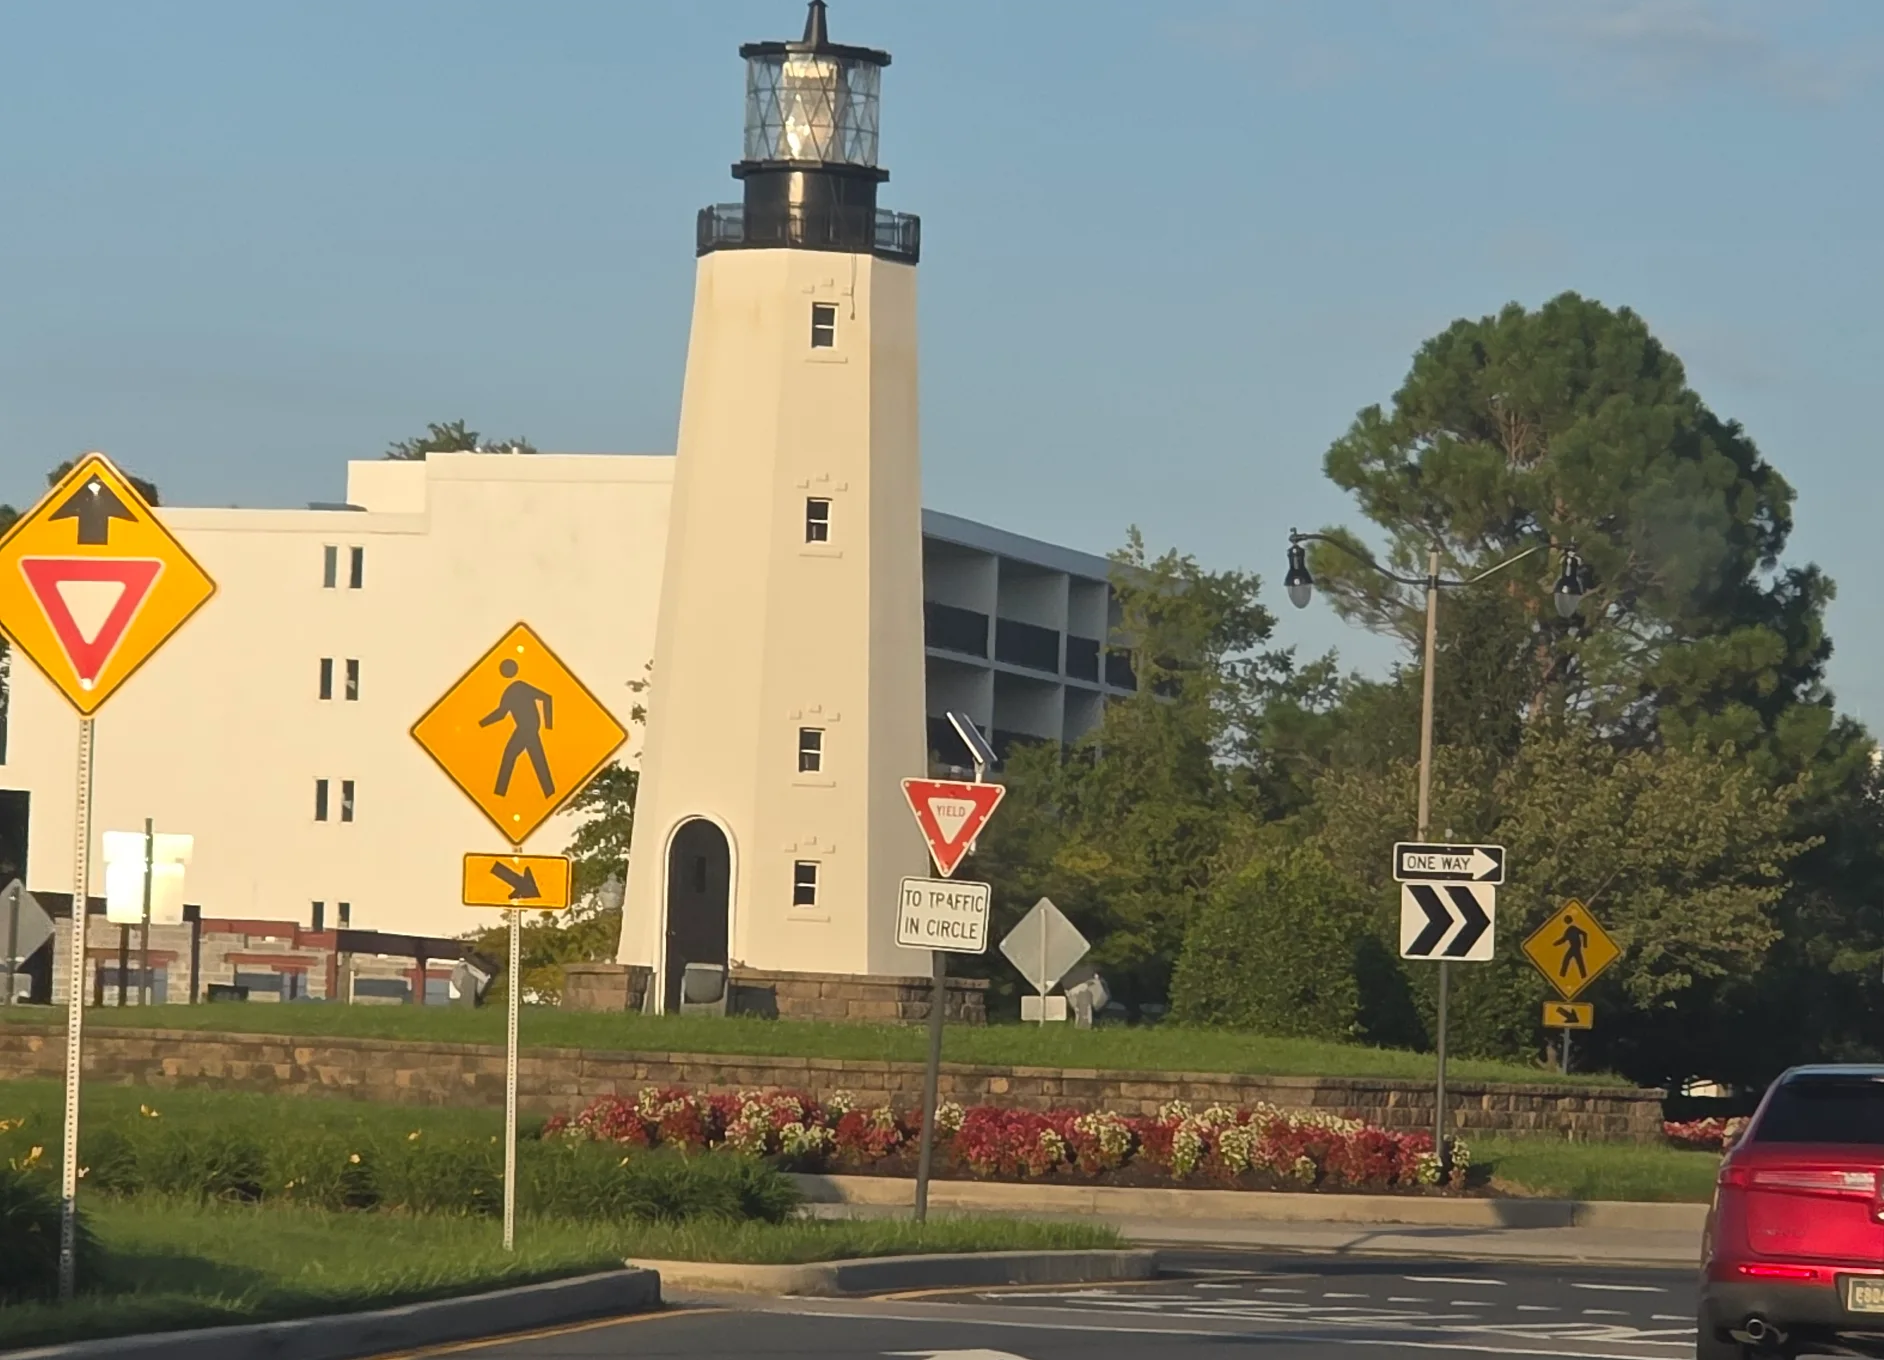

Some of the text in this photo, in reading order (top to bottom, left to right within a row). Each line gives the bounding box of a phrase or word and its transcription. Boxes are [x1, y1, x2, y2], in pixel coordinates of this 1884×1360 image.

[936, 804, 966, 818] YIELD
[1407, 855, 1471, 870] ONE WAY
[905, 889, 984, 913] TO TRAFFIC
[904, 916, 979, 940] IN CIRCLE
